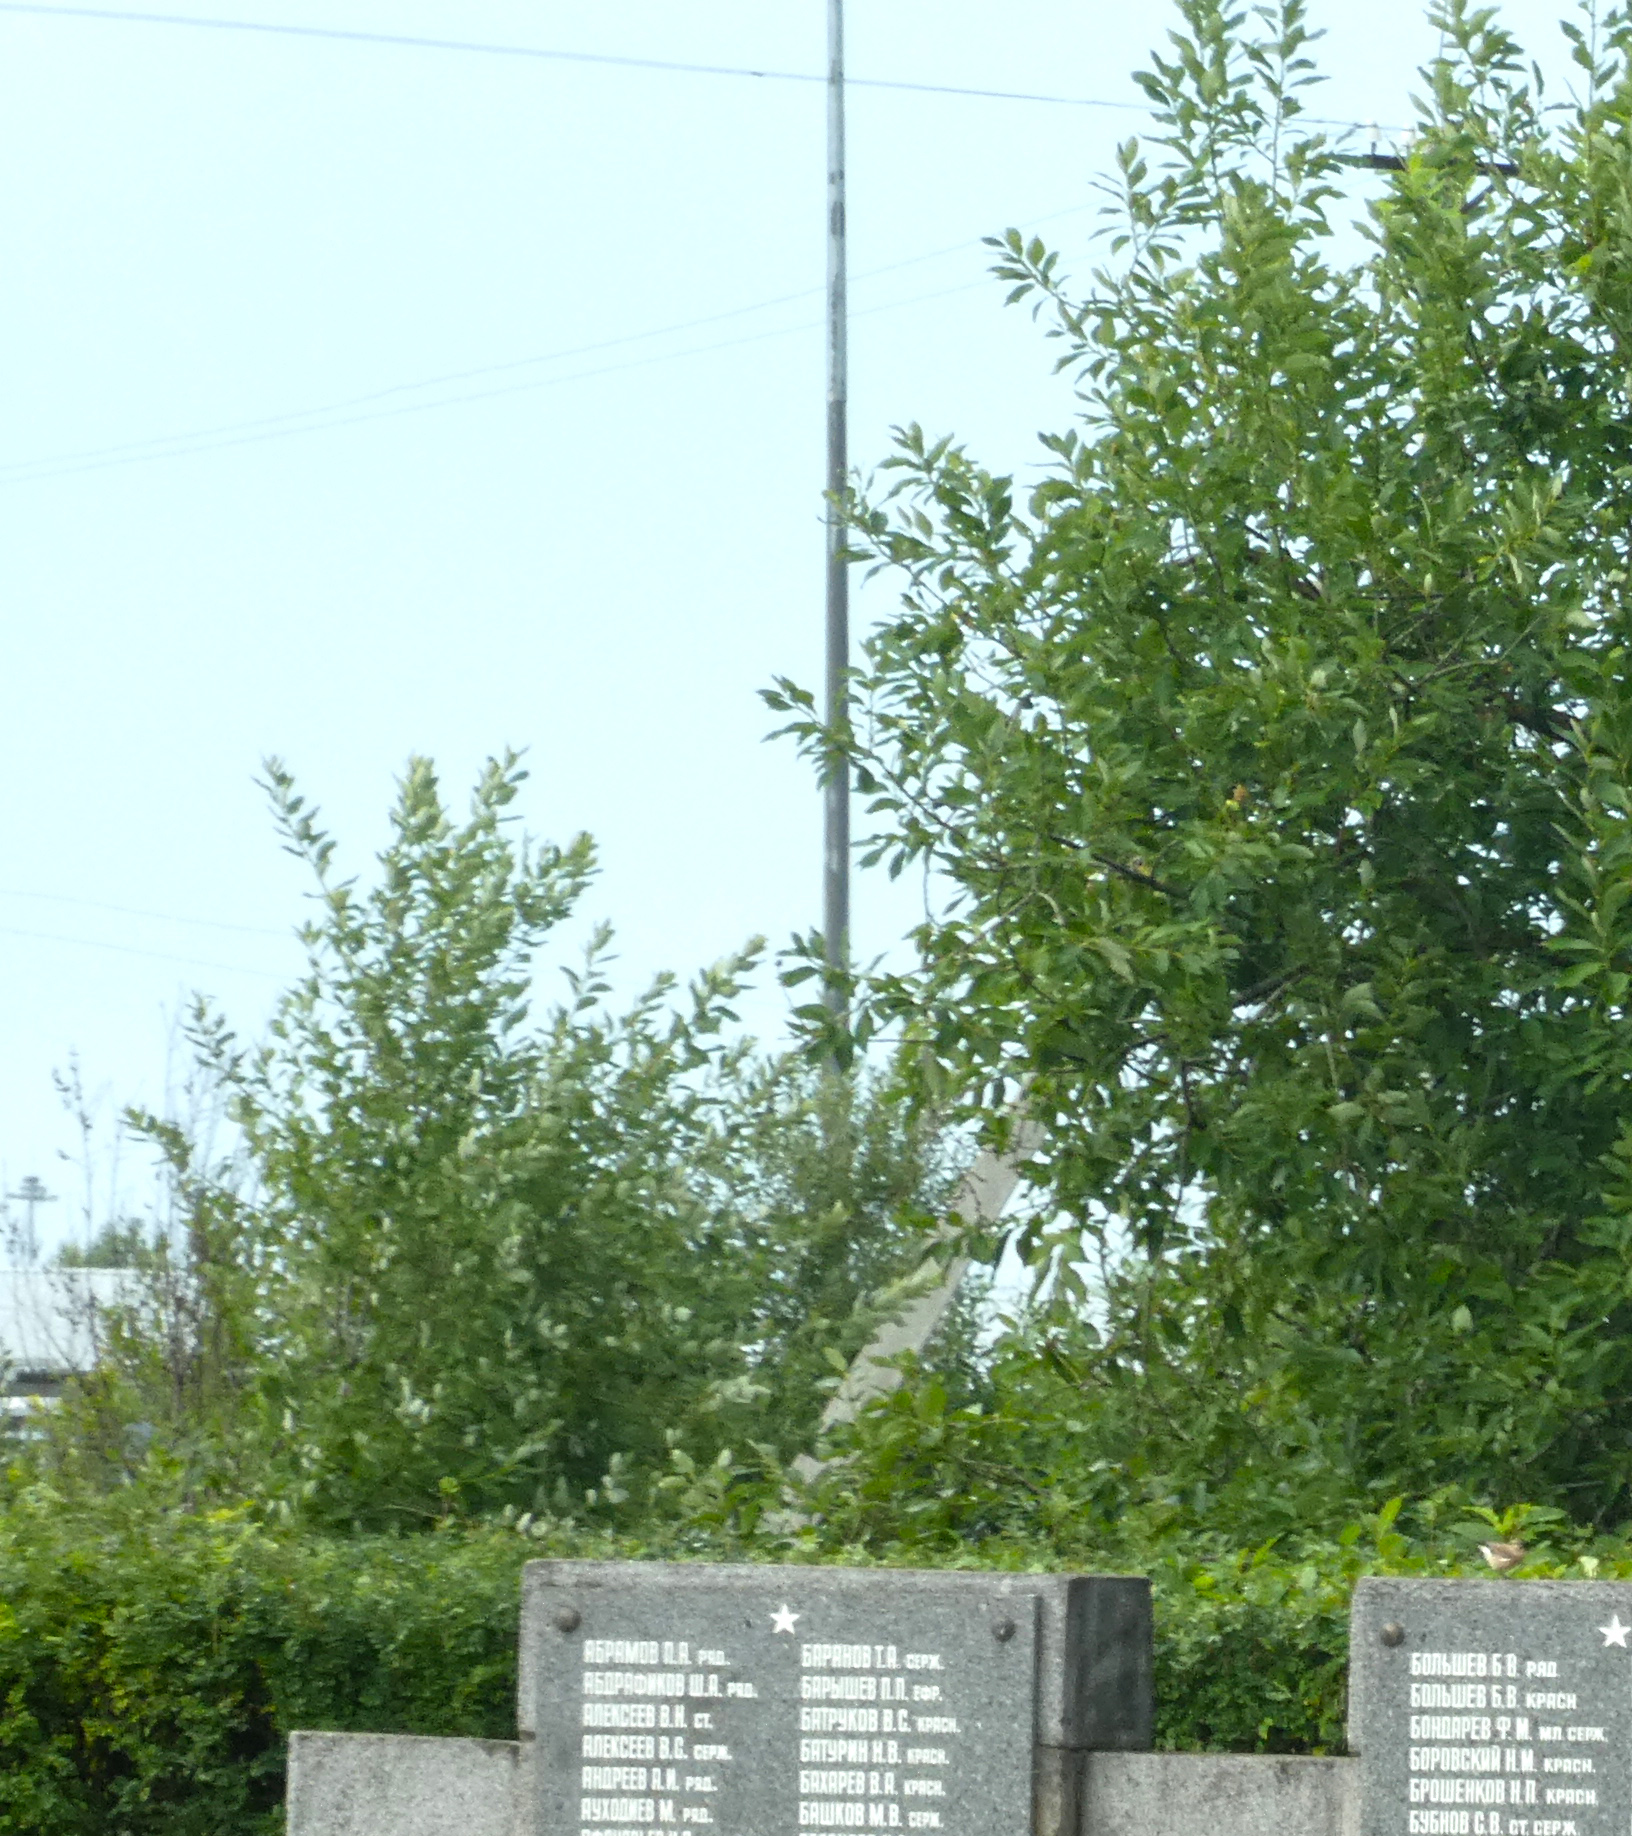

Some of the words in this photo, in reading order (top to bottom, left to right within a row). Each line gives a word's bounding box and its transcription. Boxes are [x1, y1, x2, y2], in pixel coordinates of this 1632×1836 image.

[1409, 1682, 1487, 1709] БОЛЬШЕВ
[799, 1706, 879, 1733] БАТРУКОВ
[1409, 1714, 1492, 1741] БОНДАРЕВ
[581, 1734, 656, 1760] АЛЕКСЕЕВ
[799, 1738, 869, 1763] БАТУРИН
[1409, 1743, 1502, 1772] БОРОВСКИЙ
[581, 1765, 648, 1790] АНДРЕЕВ
[798, 1769, 866, 1794] БАХАРЕВ
[1408, 1777, 1506, 1804] БРОШЕНКОВ
[798, 1801, 866, 1826] БАШКОВ
[1408, 1809, 1470, 1834] БУБНОВ
